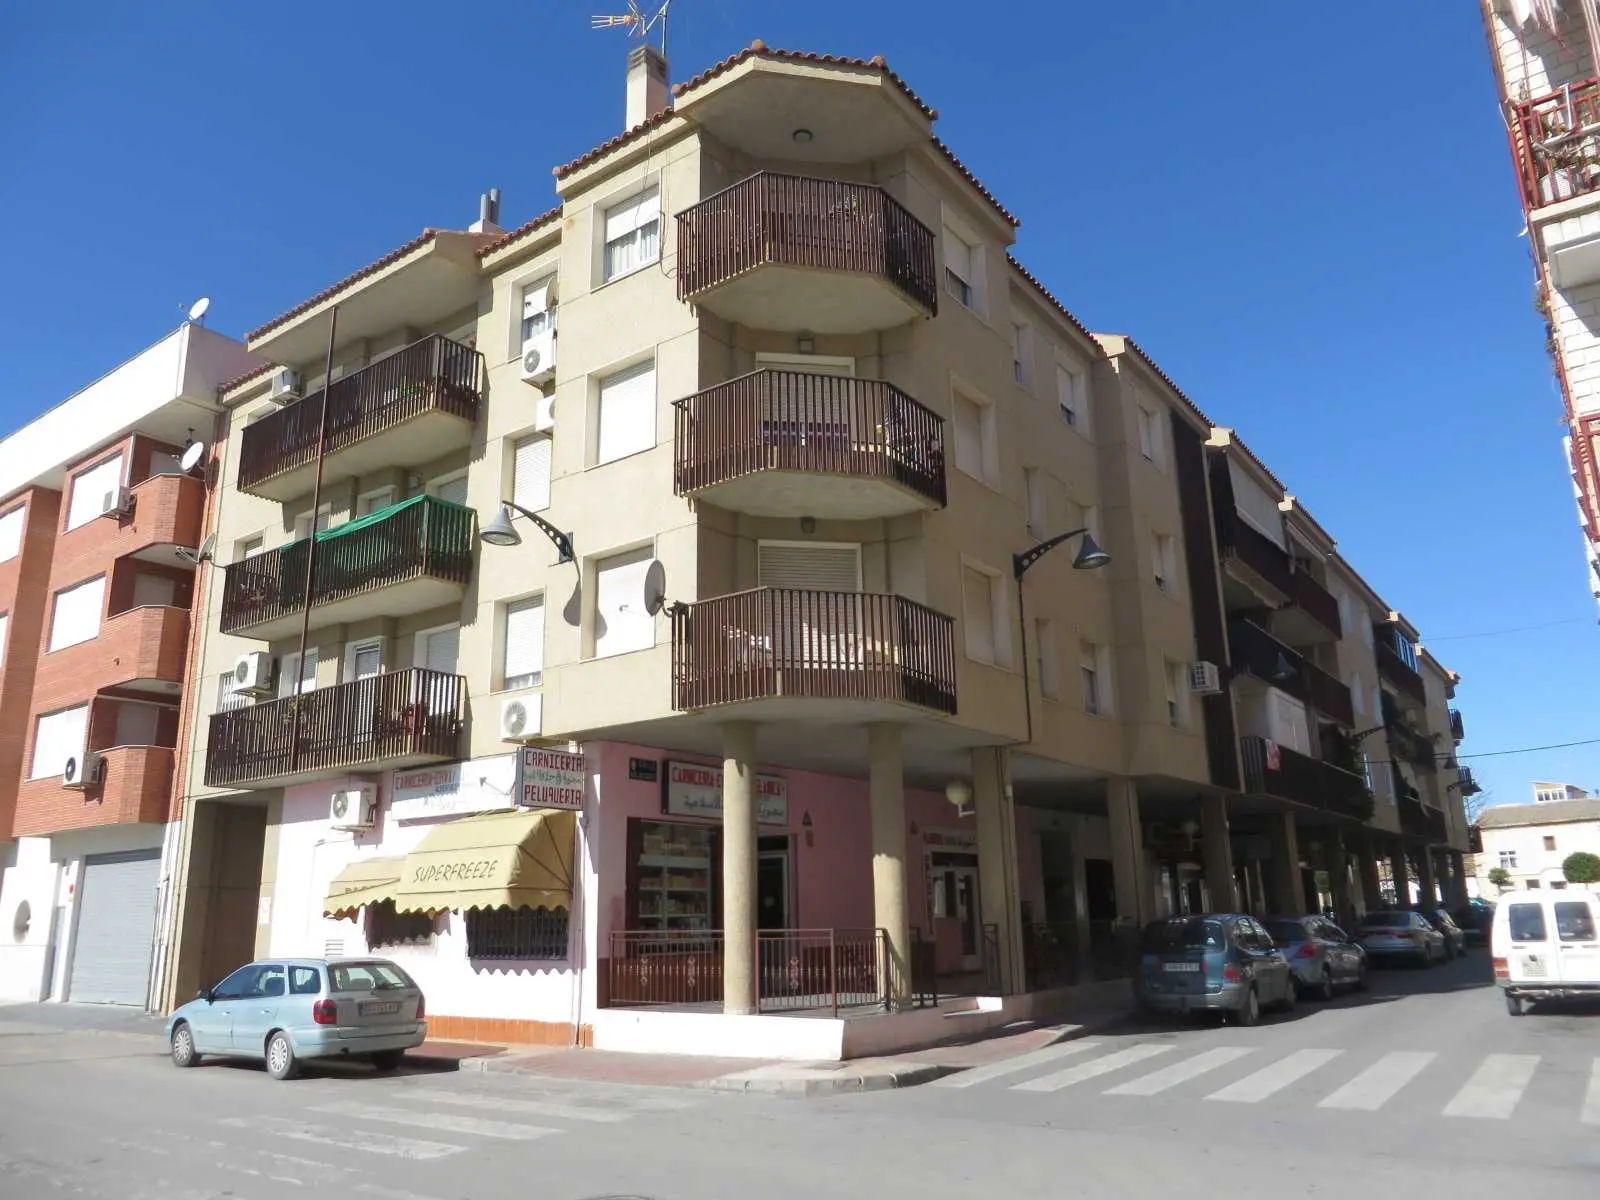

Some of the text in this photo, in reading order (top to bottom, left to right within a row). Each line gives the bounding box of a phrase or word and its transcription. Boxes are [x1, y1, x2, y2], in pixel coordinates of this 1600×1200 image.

[525, 751, 582, 772] CARNICERIA
[524, 785, 581, 805] PELUQUERIA
[412, 860, 499, 883] SUPERFREEZE
